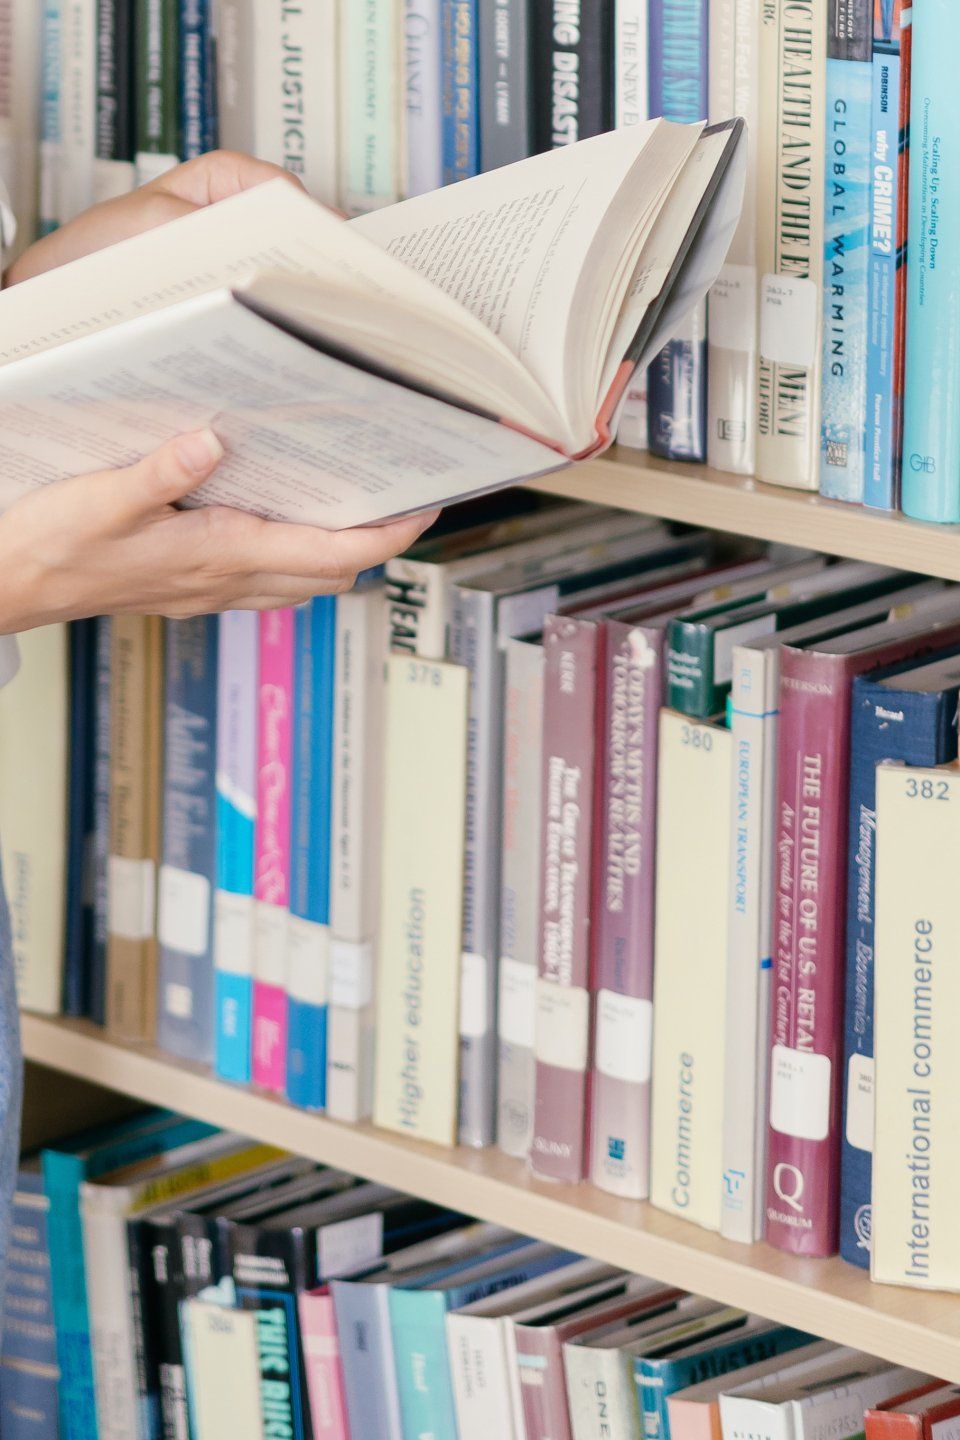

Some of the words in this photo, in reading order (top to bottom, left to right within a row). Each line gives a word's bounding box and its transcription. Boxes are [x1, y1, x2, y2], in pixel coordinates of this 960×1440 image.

[496, 9, 508, 57] SOCIETY
[623, 17, 639, 57] THE
[736, 0, 750, 77] Well-Fed
[364, 27, 378, 121] ECONOMY
[403, 13, 429, 120] CHANGE
[623, 61, 638, 108] NEW
[781, 26, 813, 128] HEALTH
[879, 64, 890, 114] ROBINSON
[282, 34, 305, 176] JUSTICE
[496, 81, 509, 126] LYMAN
[921, 97, 931, 149] Overcoming
[781, 132, 812, 191] AND
[831, 98, 848, 218] GLOBAL
[873, 129, 888, 162] why
[928, 136, 941, 175] Scaling
[920, 150, 930, 202] Malnutrition
[928, 177, 940, 194] Up,
[781, 195, 811, 247] THE
[871, 165, 893, 253] CRIME?
[927, 196, 938, 235] Scaling
[917, 214, 928, 263] Developing
[928, 237, 938, 269] Down
[830, 234, 845, 378] WARMING
[918, 264, 926, 306] Countries
[873, 393, 883, 424] Pearson
[872, 427, 882, 461] Prentice
[872, 462, 882, 480] Hall
[559, 650, 575, 693] KERR
[681, 725, 713, 752] 380
[625, 747, 643, 824] MYTHS
[736, 740, 750, 820] EUROPEAN
[803, 753, 822, 796] THE
[905, 778, 950, 801] 382
[781, 802, 795, 826] An
[607, 799, 625, 912] REALITIES
[624, 829, 642, 875] AND
[735, 826, 748, 914] TRANSPORT
[778, 831, 794, 890] Agenda
[799, 805, 820, 893] FUTURE
[855, 803, 876, 923] Management
[776, 893, 793, 918] for
[798, 899, 818, 931] OF
[402, 887, 426, 1026] education
[778, 921, 792, 946] the
[798, 936, 816, 979] U.S.
[777, 949, 792, 982] 21st
[913, 917, 935, 1077] commerce
[400, 1037, 425, 1128] Higher
[672, 1051, 696, 1210] Commerce
[773, 1162, 803, 1212] Q
[903, 1086, 933, 1280] International
[767, 1208, 812, 1229] QUORUM
